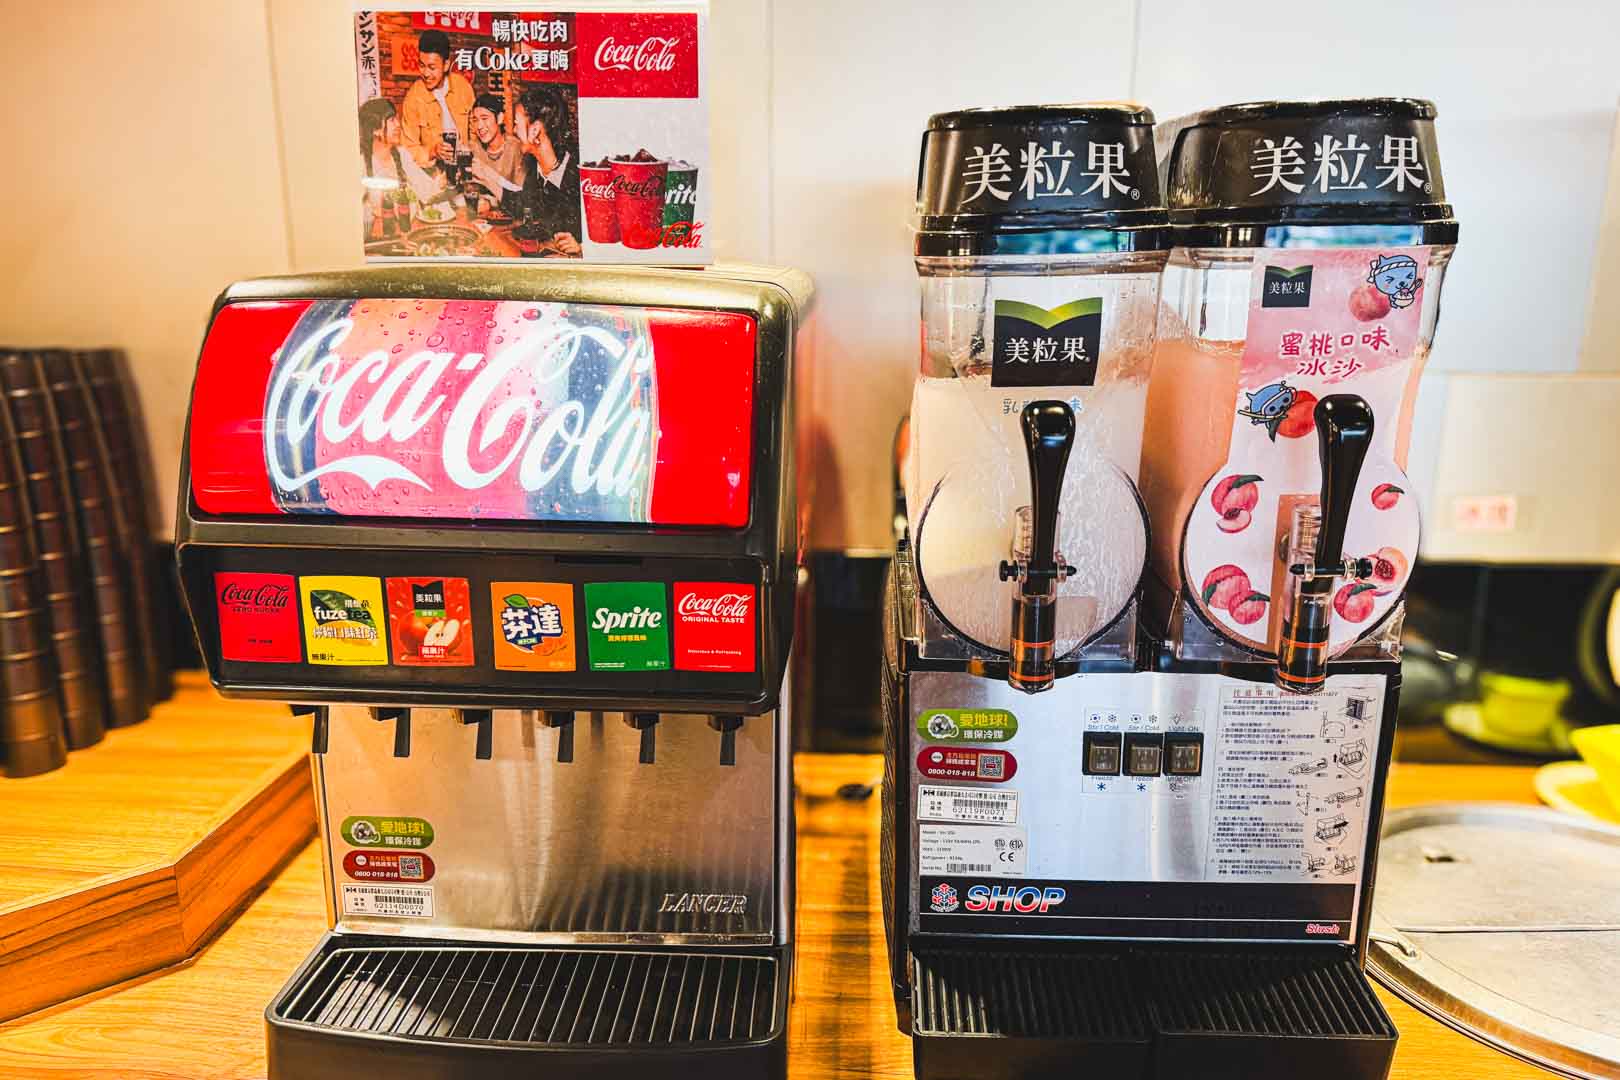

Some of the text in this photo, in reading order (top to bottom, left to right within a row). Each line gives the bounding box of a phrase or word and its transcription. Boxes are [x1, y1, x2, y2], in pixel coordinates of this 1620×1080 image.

[492, 19, 568, 42] 暢快吃肉
[594, 36, 680, 72] Coca-Cola
[962, 140, 1131, 205] 美粒果
[1250, 134, 1425, 197] 美粒果
[1269, 281, 1305, 295] 美粒果
[1004, 337, 1087, 364] 美粒果
[1281, 326, 1390, 357] 蜜桃口味
[1297, 358, 1362, 378] 冰沙
[265, 318, 655, 496] Coca-Cola
[221, 583, 289, 608] Coca-Cola
[678, 592, 753, 618] Coca-Cola
[314, 607, 348, 620] fuze
[501, 604, 562, 642] 芬達
[591, 606, 662, 634] Sprite
[682, 616, 719, 624] ORIGINAL
[965, 885, 1066, 913] SHOP
